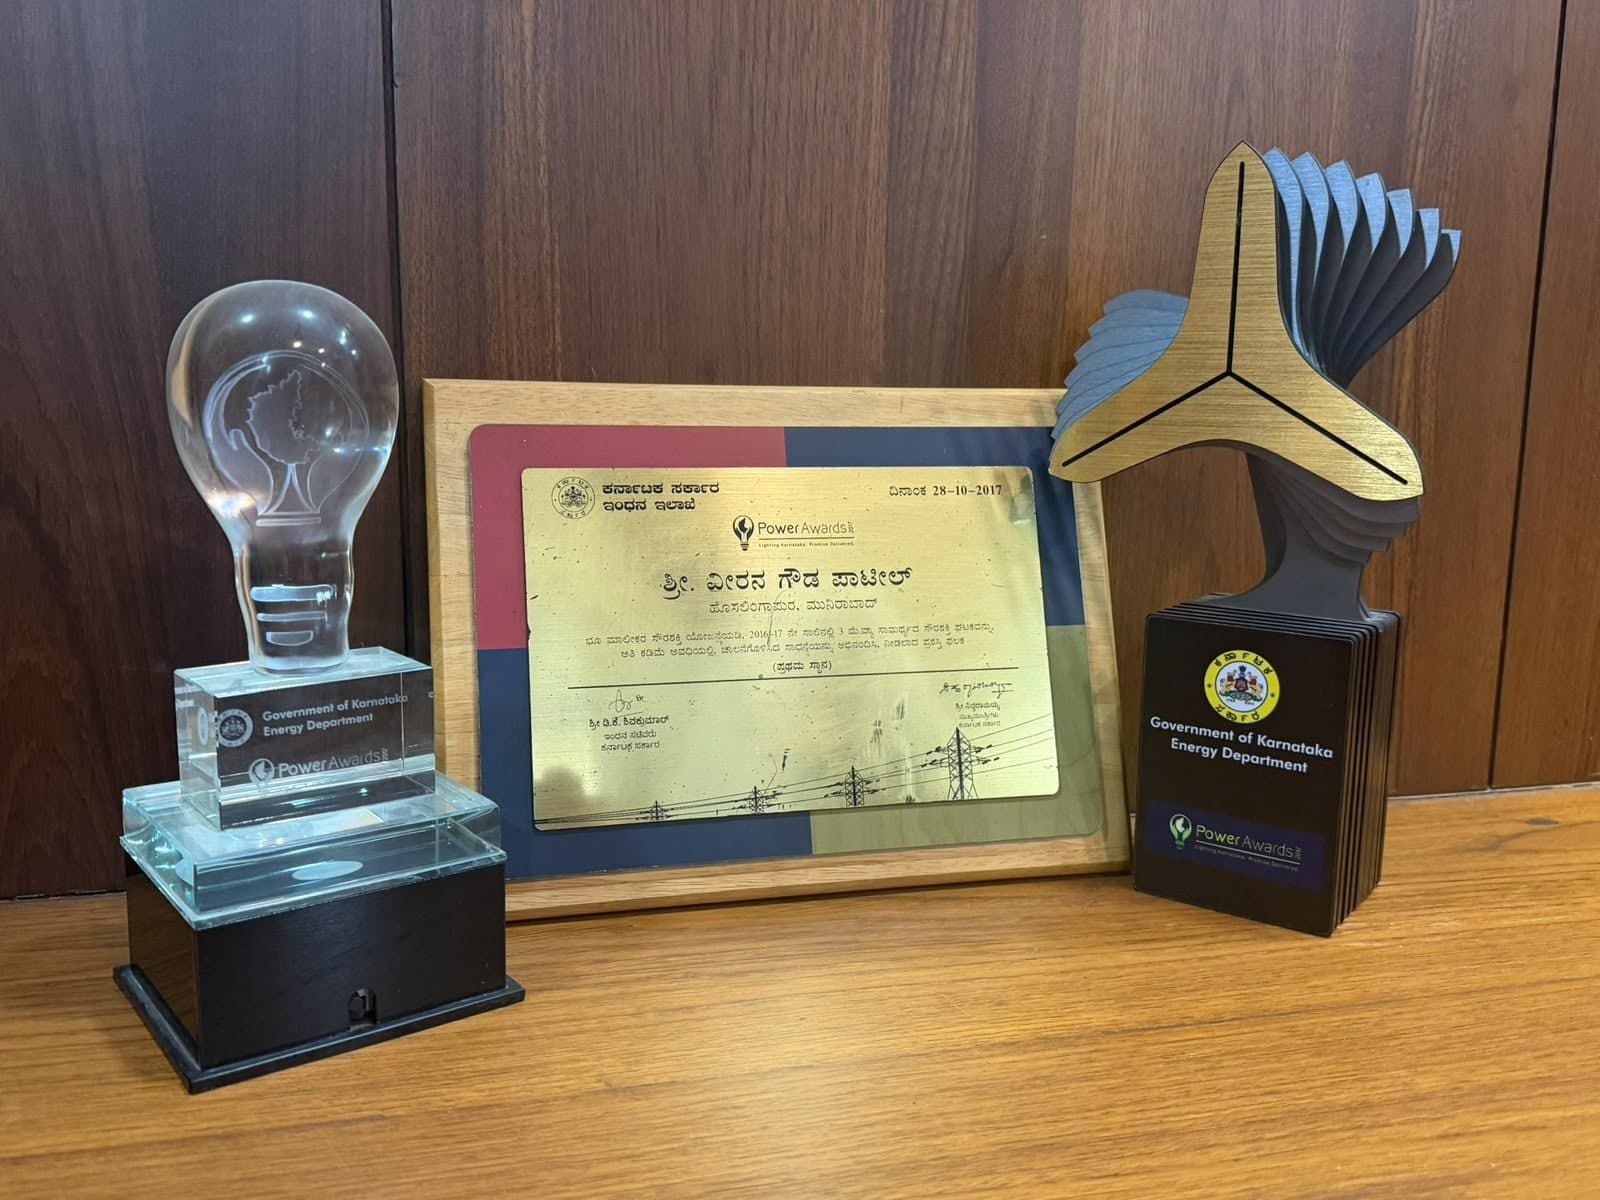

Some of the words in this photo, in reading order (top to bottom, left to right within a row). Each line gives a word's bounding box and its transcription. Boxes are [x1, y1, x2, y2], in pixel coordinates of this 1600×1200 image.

[602, 482, 664, 495] ಕರ್ನಾಟಕ
[671, 481, 720, 494] ಸರ್ಕಾರ
[889, 484, 927, 497] ದಿನಾಂಕ
[933, 484, 1002, 496] 28-10-2017
[602, 499, 647, 513] ಇಂಧನ
[654, 497, 697, 511] ಇಲಾಖೆ
[706, 569, 766, 592] ವೀರನ
[778, 567, 820, 590] ಗೌಡ
[832, 566, 912, 588] ಪಾಟೀಲ್
[262, 703, 334, 722] Government
[337, 700, 349, 712] of
[351, 692, 408, 710] Karnataka
[263, 723, 304, 738] Energy
[307, 713, 373, 731] Department
[1150, 716, 1234, 742] Government
[1238, 732, 1254, 744] of
[1257, 734, 1334, 759] Karnataka
[1171, 738, 1218, 759] Energy
[1222, 746, 1308, 773] Department
